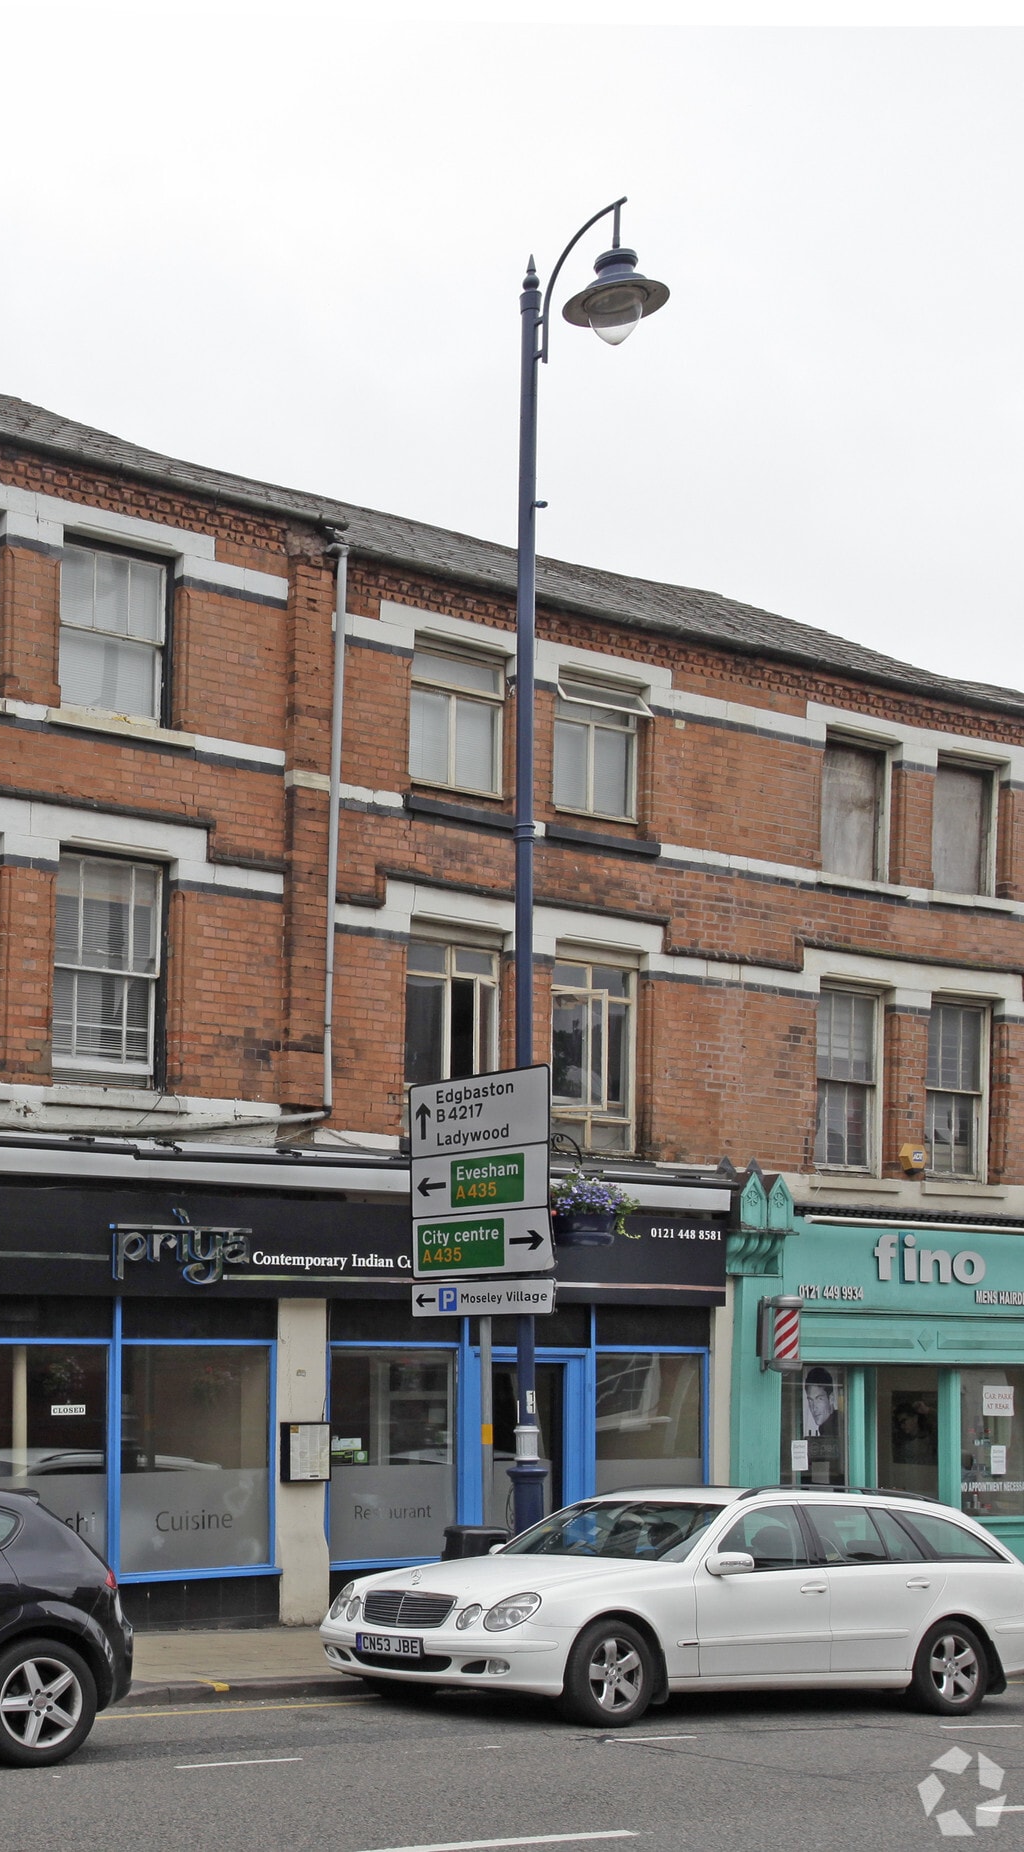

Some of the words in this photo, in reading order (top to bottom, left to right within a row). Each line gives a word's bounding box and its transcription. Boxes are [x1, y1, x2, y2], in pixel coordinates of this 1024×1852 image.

[436, 1082, 514, 1104] Edgbaston
[436, 1123, 510, 1146] Ladywood
[456, 1163, 519, 1181] Evesham
[422, 1230, 450, 1246] City
[454, 1226, 500, 1242] centre
[650, 1227, 675, 1239] 0121
[677, 1229, 696, 1240] 448
[698, 1230, 722, 1241] 8581
[109, 1208, 252, 1284] priya
[252, 1251, 348, 1270] Contemporary
[351, 1254, 394, 1269] Indian
[874, 1234, 986, 1285] fino
[442, 1290, 455, 1310] P
[460, 1293, 502, 1305] Moseley
[506, 1291, 548, 1304] Village
[798, 1284, 821, 1299] 0121
[822, 1285, 840, 1300] 449
[841, 1286, 864, 1301] 9934
[975, 1290, 998, 1304] MENS
[999, 1291, 1024, 1306] HAIRD
[52, 1406, 85, 1414] CLOSED
[155, 1509, 233, 1532] Cuisine
[362, 1636, 391, 1651] CN53
[394, 1639, 419, 1654] JBE
